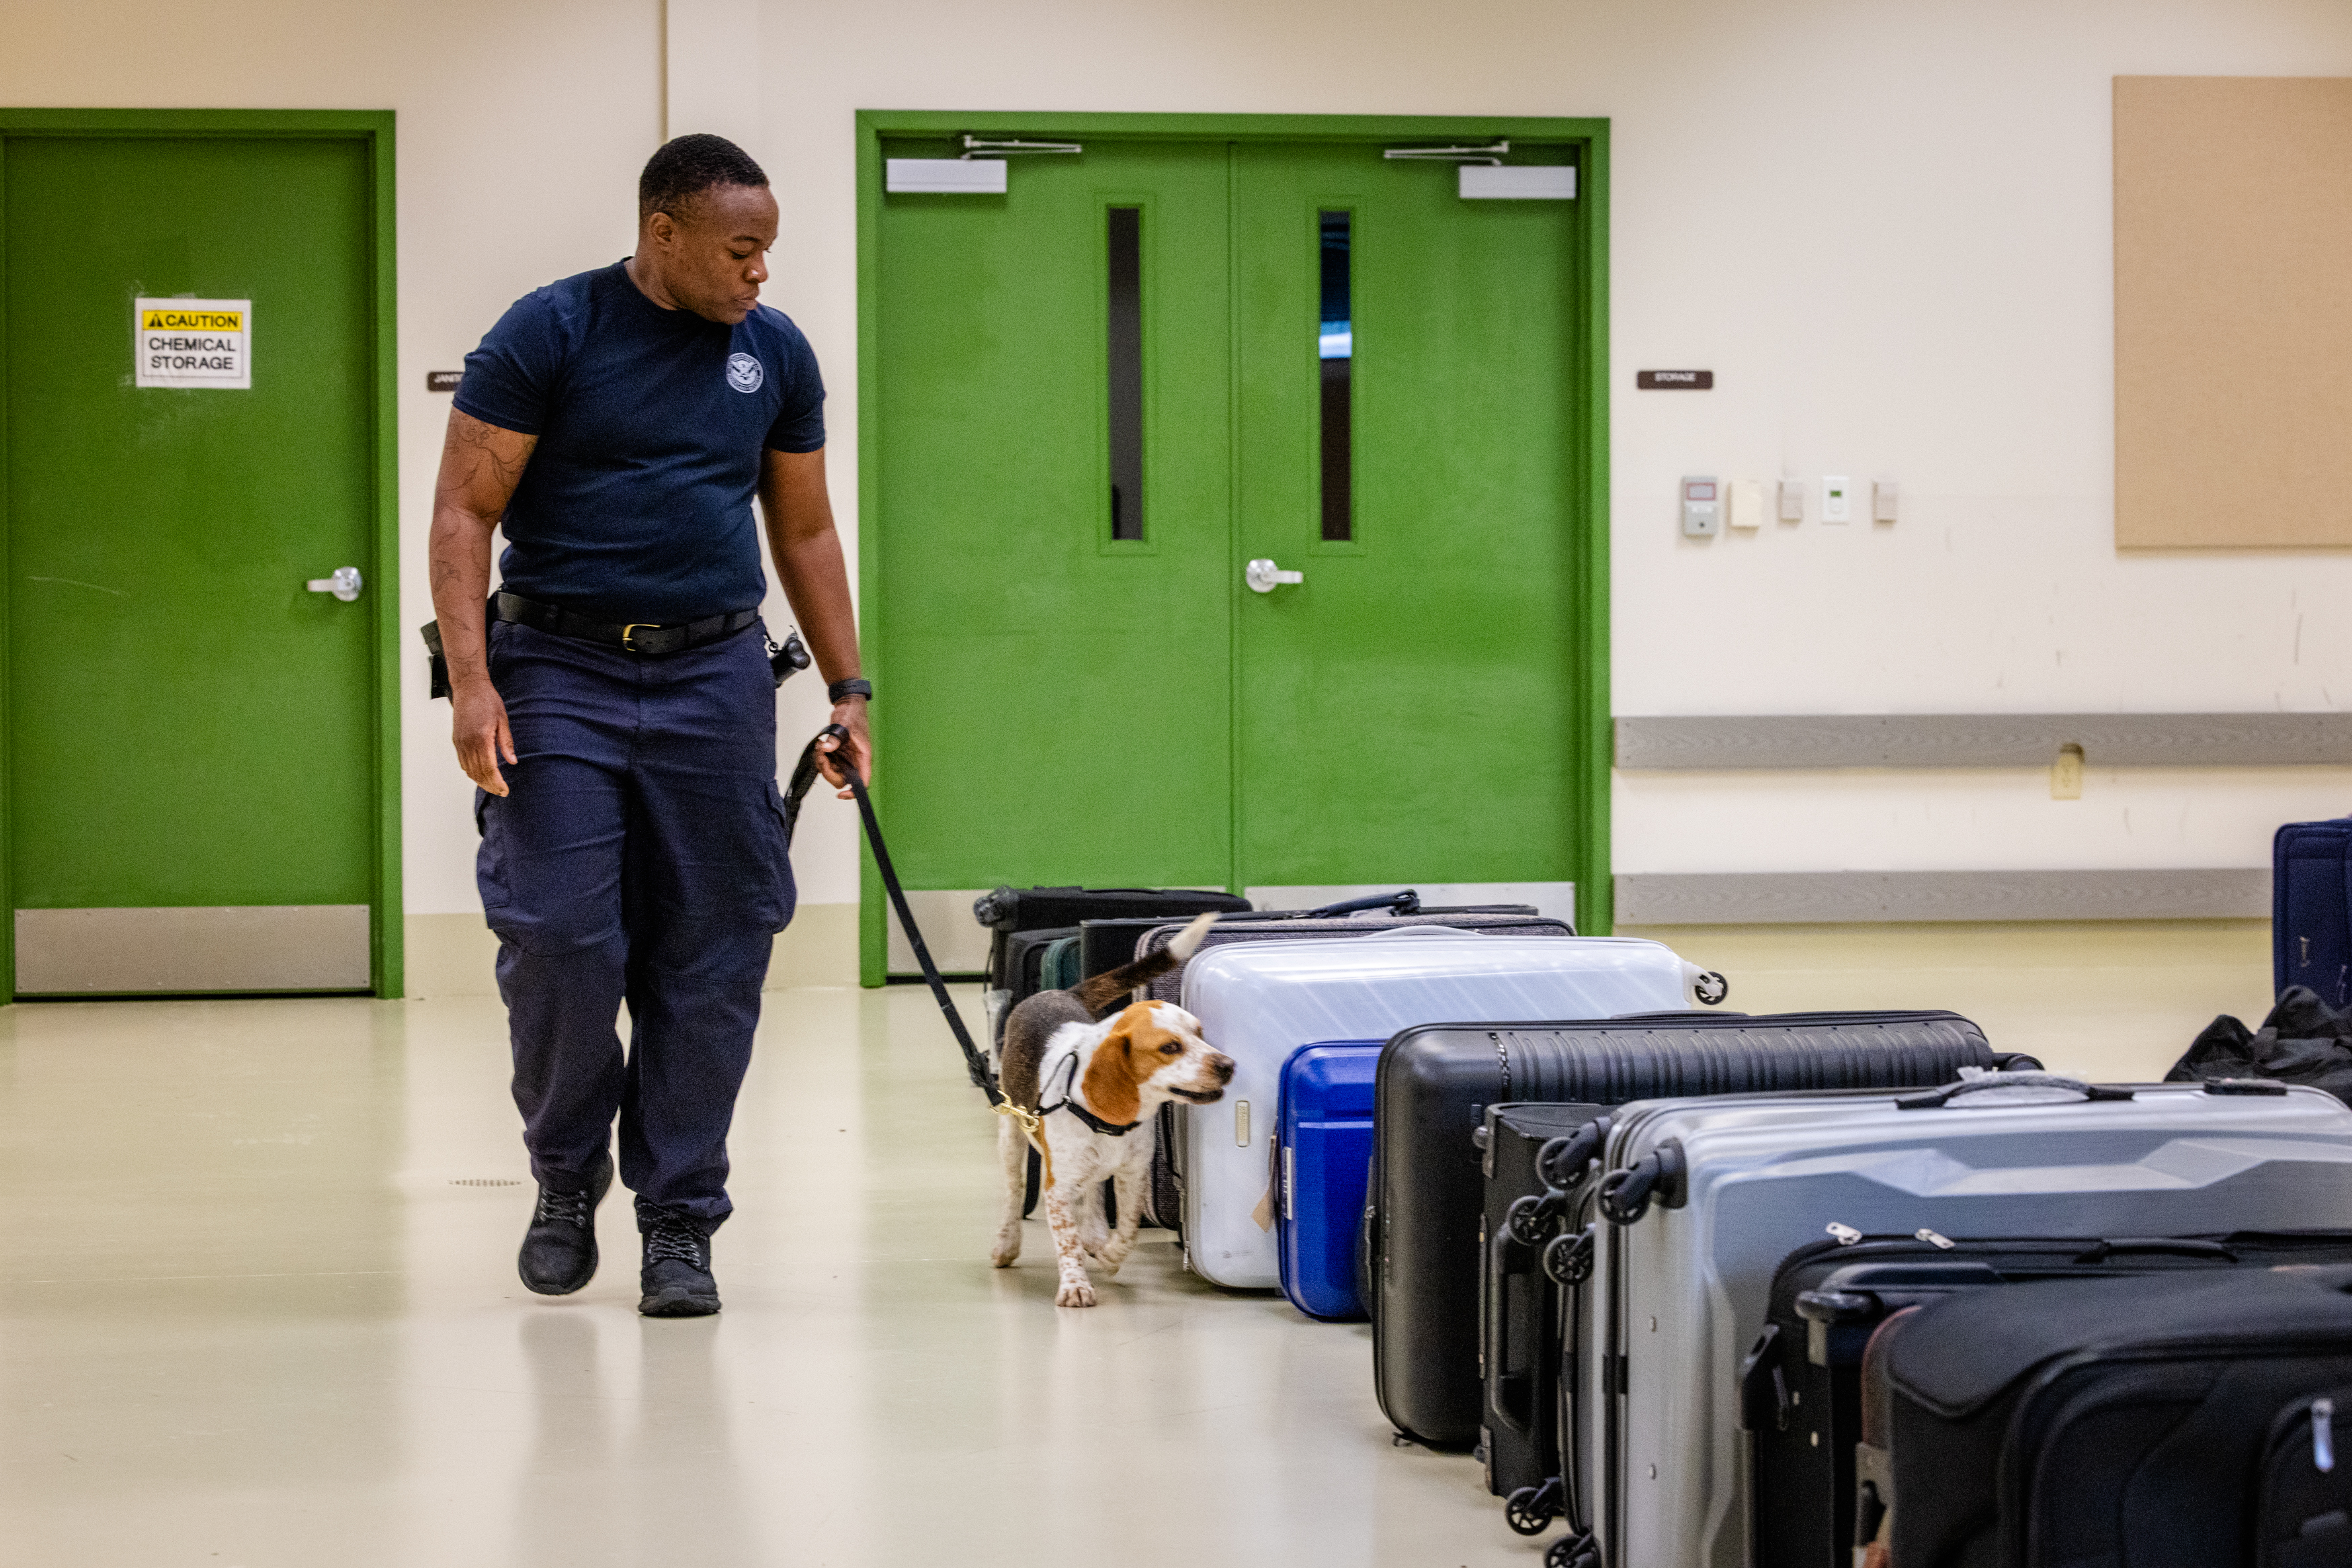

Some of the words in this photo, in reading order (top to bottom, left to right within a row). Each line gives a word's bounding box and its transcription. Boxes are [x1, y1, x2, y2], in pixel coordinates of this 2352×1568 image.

[165, 314, 238, 327] CAUTION
[149, 337, 236, 351] CHEMICAL
[151, 355, 234, 369] STORAGE
